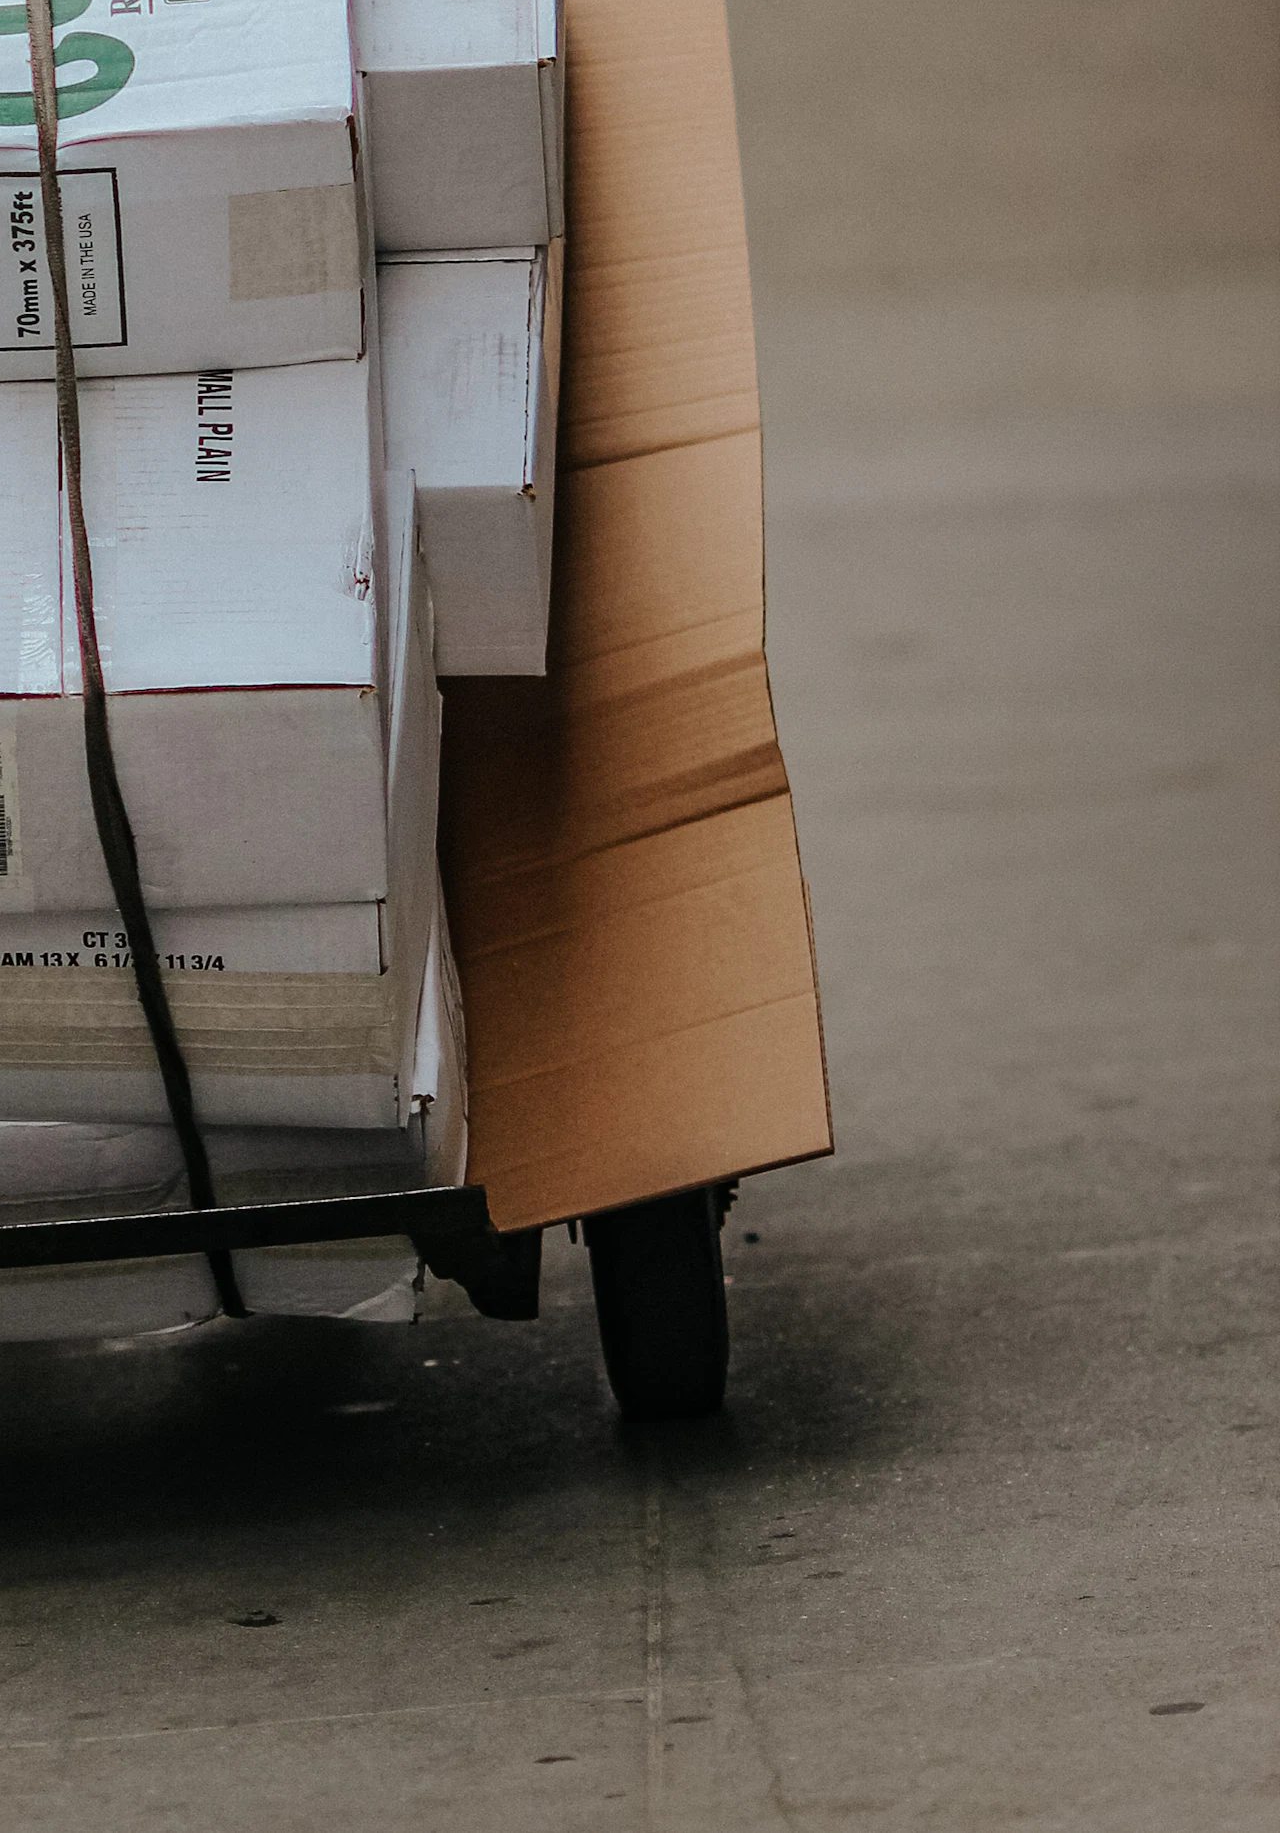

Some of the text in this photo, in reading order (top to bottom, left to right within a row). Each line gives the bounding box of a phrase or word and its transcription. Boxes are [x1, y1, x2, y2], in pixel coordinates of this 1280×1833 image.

[10, 191, 36, 253] 375ft
[78, 213, 98, 316] MADE IN THE USA
[16, 279, 41, 338] 70mm
[195, 423, 233, 482] PLAIN
[1, 952, 35, 967] AM
[39, 952, 63, 967] 13
[67, 952, 80, 967] X
[94, 952, 108, 968] 6
[165, 954, 186, 970] 11
[191, 955, 226, 971] 3/4
[82, 931, 109, 949] CT
